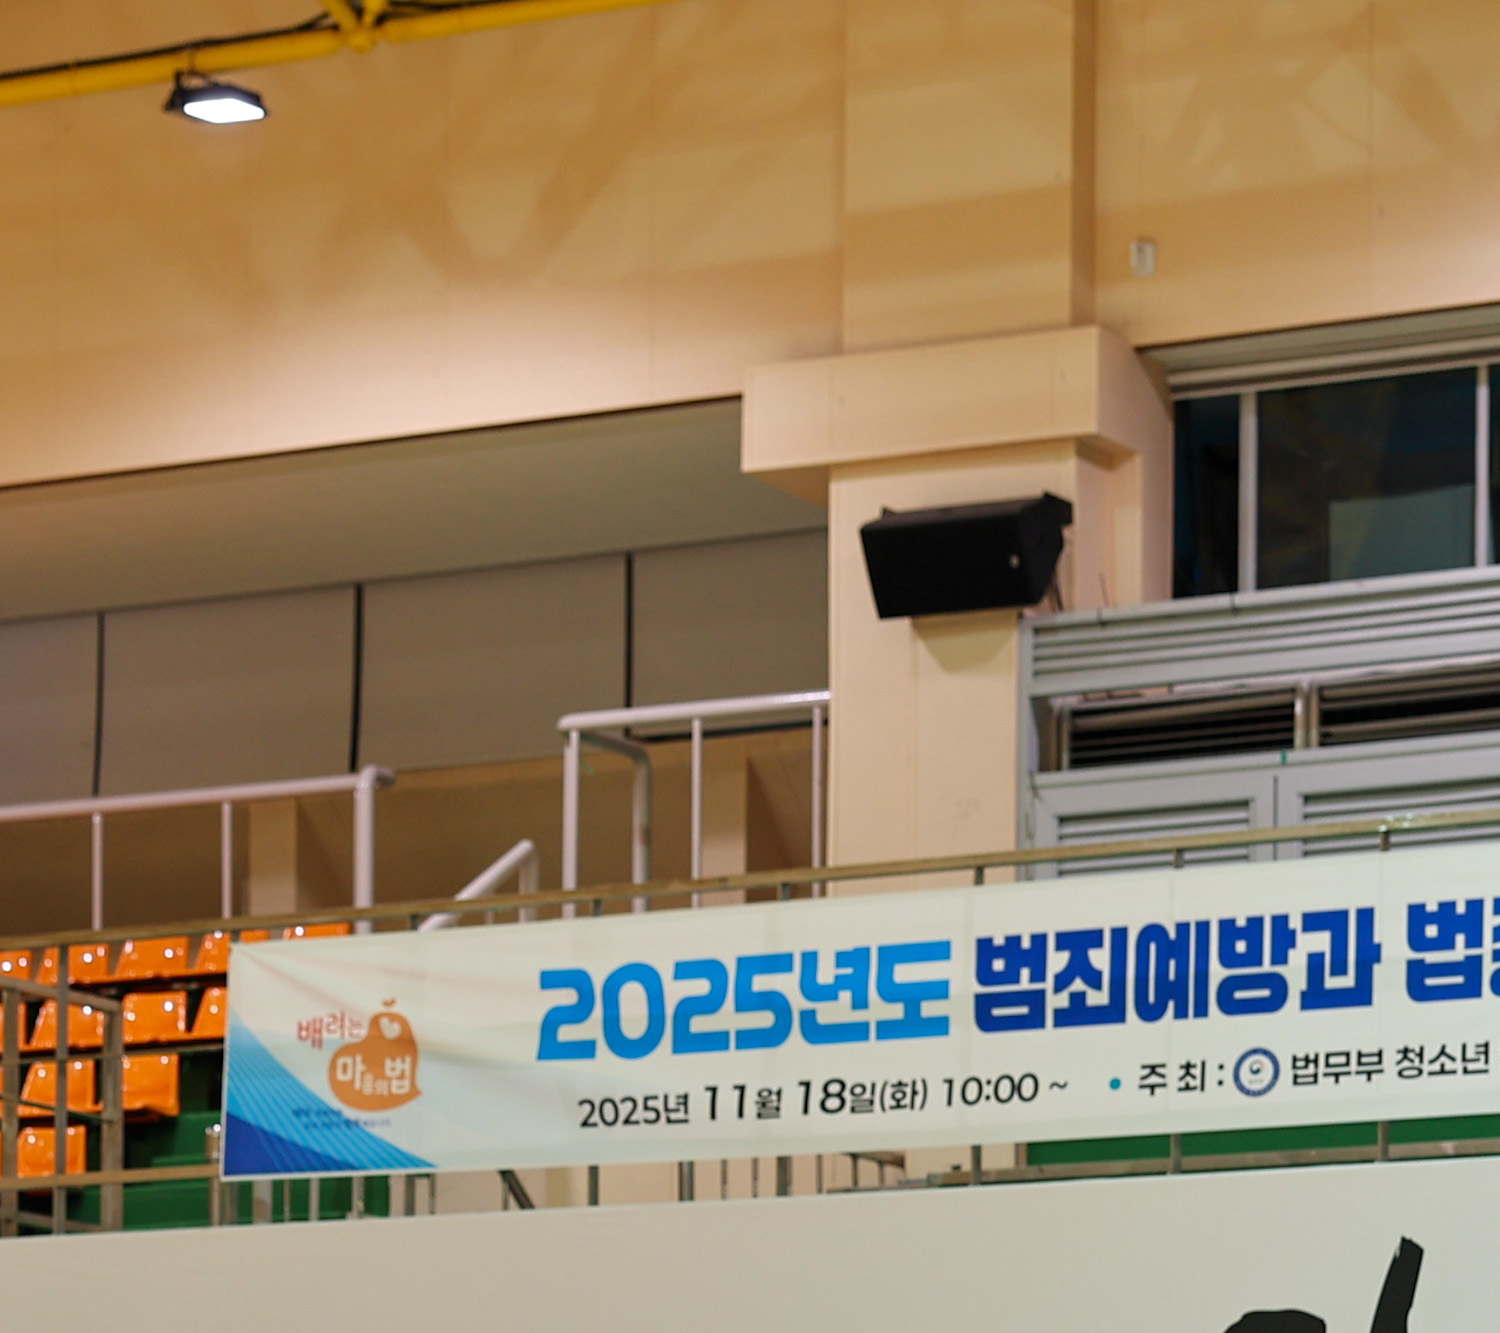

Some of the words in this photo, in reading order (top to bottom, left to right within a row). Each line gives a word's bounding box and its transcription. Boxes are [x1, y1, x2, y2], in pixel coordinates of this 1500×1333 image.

[536, 939, 952, 1061] 2025년도
[973, 906, 1382, 1034] 범죄예방과
[1291, 1047, 1386, 1087] 법무부
[1395, 1039, 1492, 1080] 청소년
[579, 1091, 690, 1129] 2025년
[704, 1083, 782, 1121] 11월
[797, 1077, 928, 1117] 18일(화)
[942, 1072, 1039, 1109] 10:00
